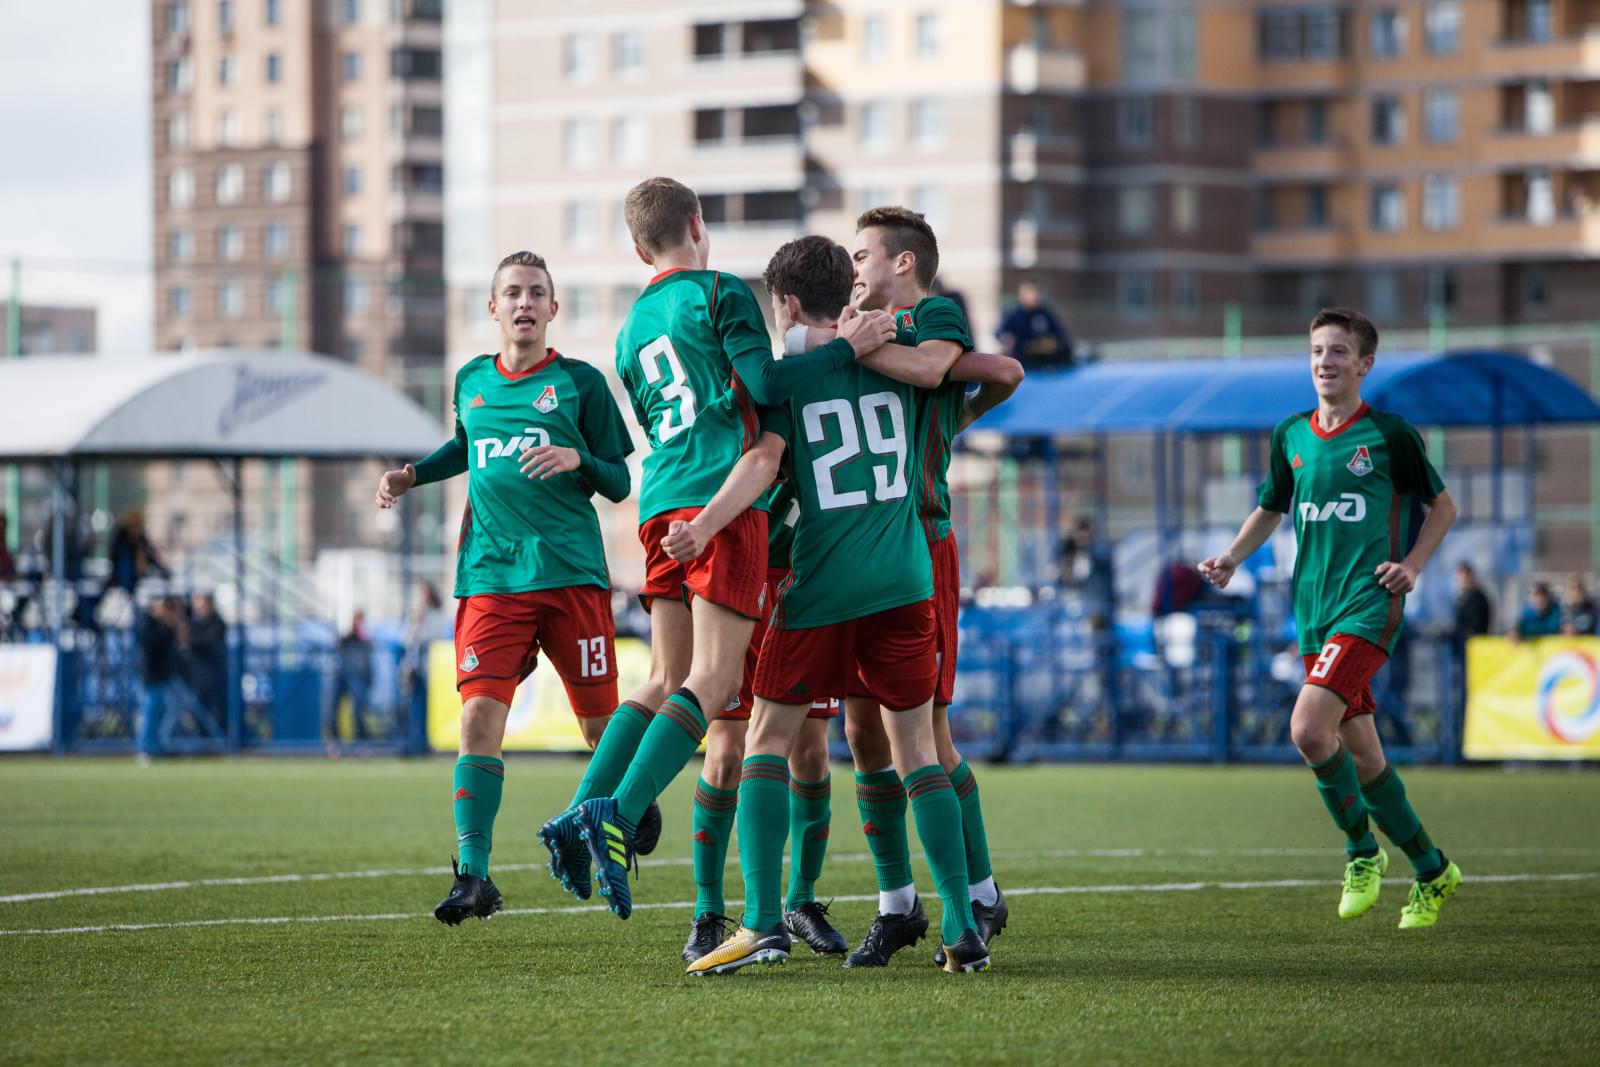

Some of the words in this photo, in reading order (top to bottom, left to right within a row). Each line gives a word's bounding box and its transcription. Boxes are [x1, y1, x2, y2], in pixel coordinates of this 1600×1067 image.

[639, 334, 697, 444] 3
[802, 391, 908, 510] 29
[577, 635, 608, 678] 13
[1310, 642, 1342, 679] 9
